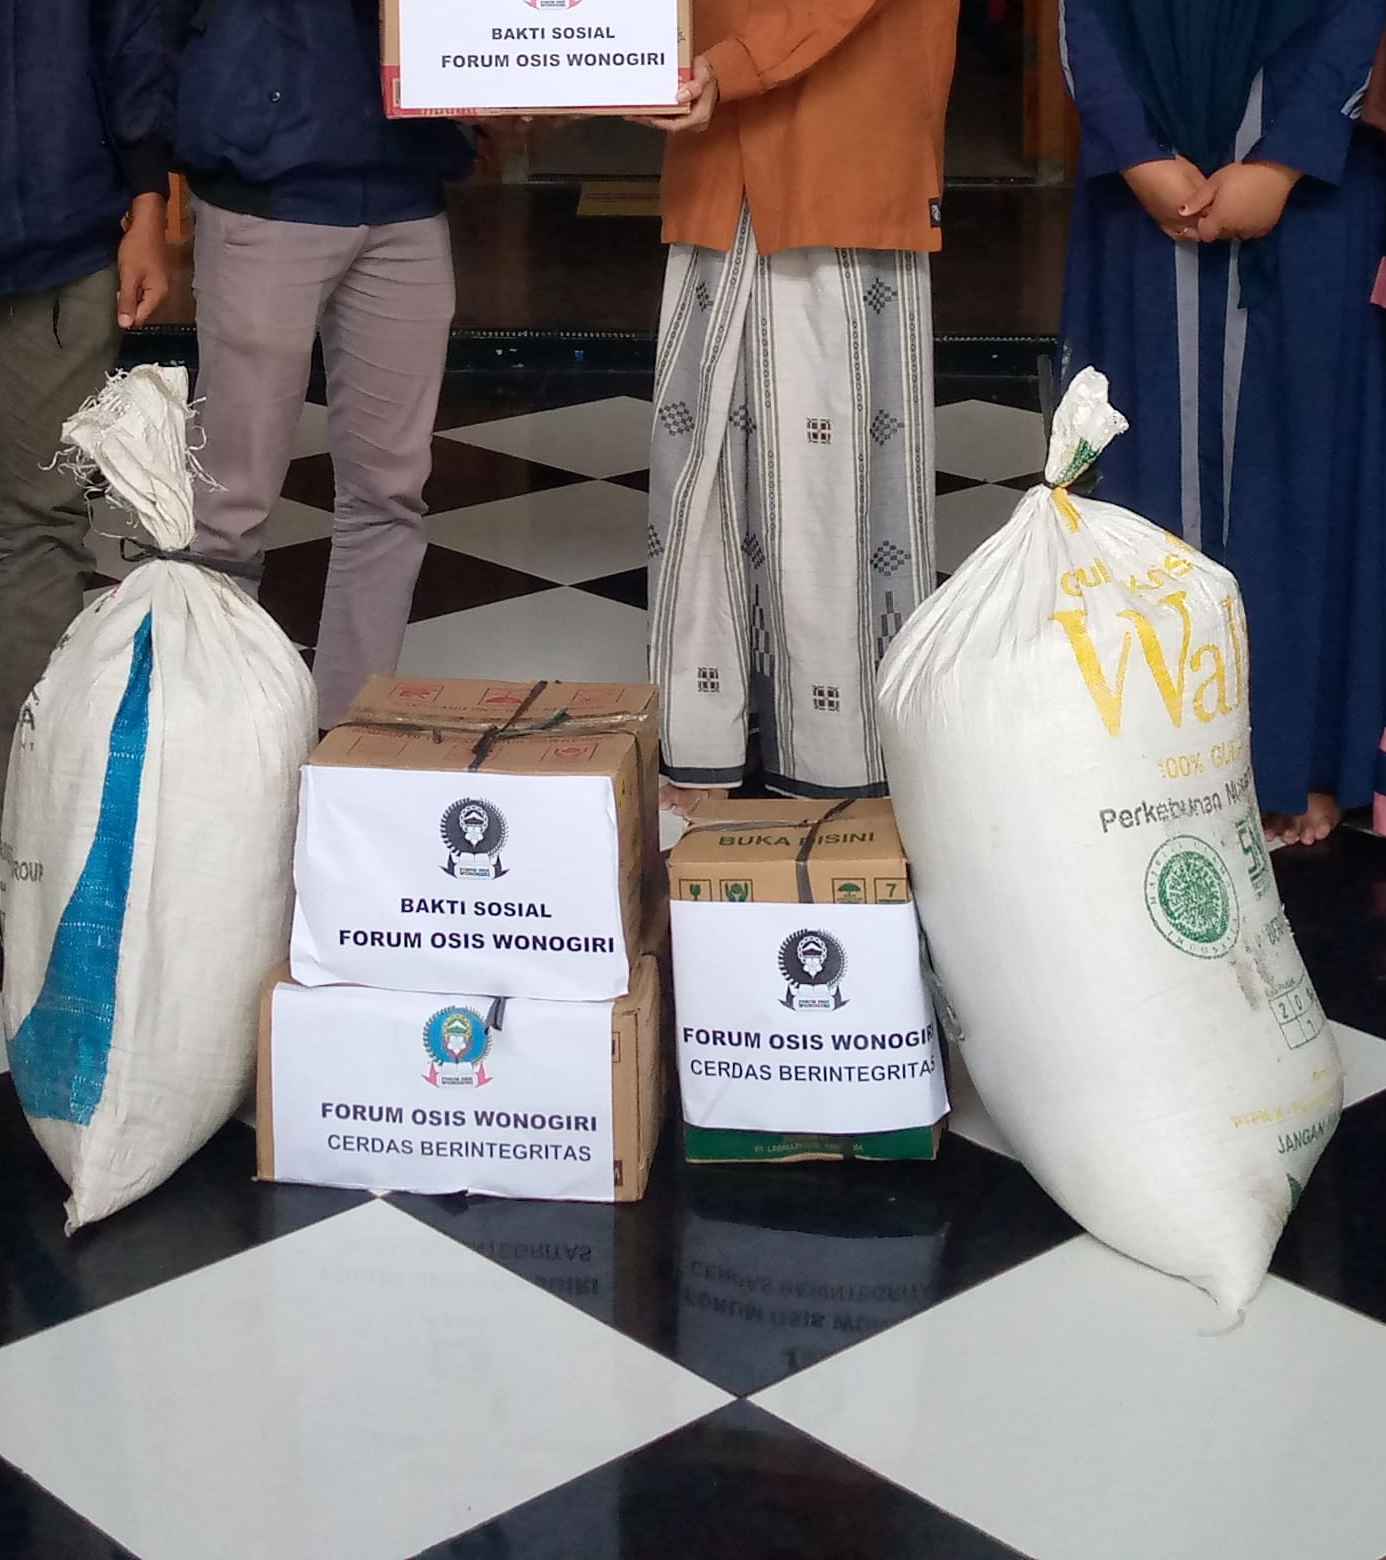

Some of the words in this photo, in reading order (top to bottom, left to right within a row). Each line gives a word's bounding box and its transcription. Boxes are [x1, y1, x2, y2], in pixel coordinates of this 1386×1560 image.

[492, 28, 544, 40] BAKTI
[552, 27, 615, 39] SOSIAL
[442, 55, 509, 68] FORUM
[517, 54, 560, 67] OSIS
[567, 53, 664, 66] WONOGIRI
[1099, 792, 1222, 834] Perkebunan
[719, 836, 791, 847] BUKA
[402, 899, 465, 915] BAKTI
[474, 902, 551, 917] SOSIAL
[340, 930, 421, 948] FORUM
[431, 933, 484, 948] OSIS
[493, 934, 614, 953] WONOGIRI
[684, 1027, 760, 1048] FORUM
[769, 1034, 823, 1050] OSIS
[691, 1060, 771, 1080] CERDAS
[780, 1056, 935, 1082] BERINTEGRITAS
[322, 1103, 402, 1123] FORUM
[412, 1109, 465, 1126] OSIS
[474, 1111, 596, 1131] WONOGIRI
[328, 1135, 413, 1154] CERDAS
[421, 1141, 591, 1161] BERINTEGRITAS
